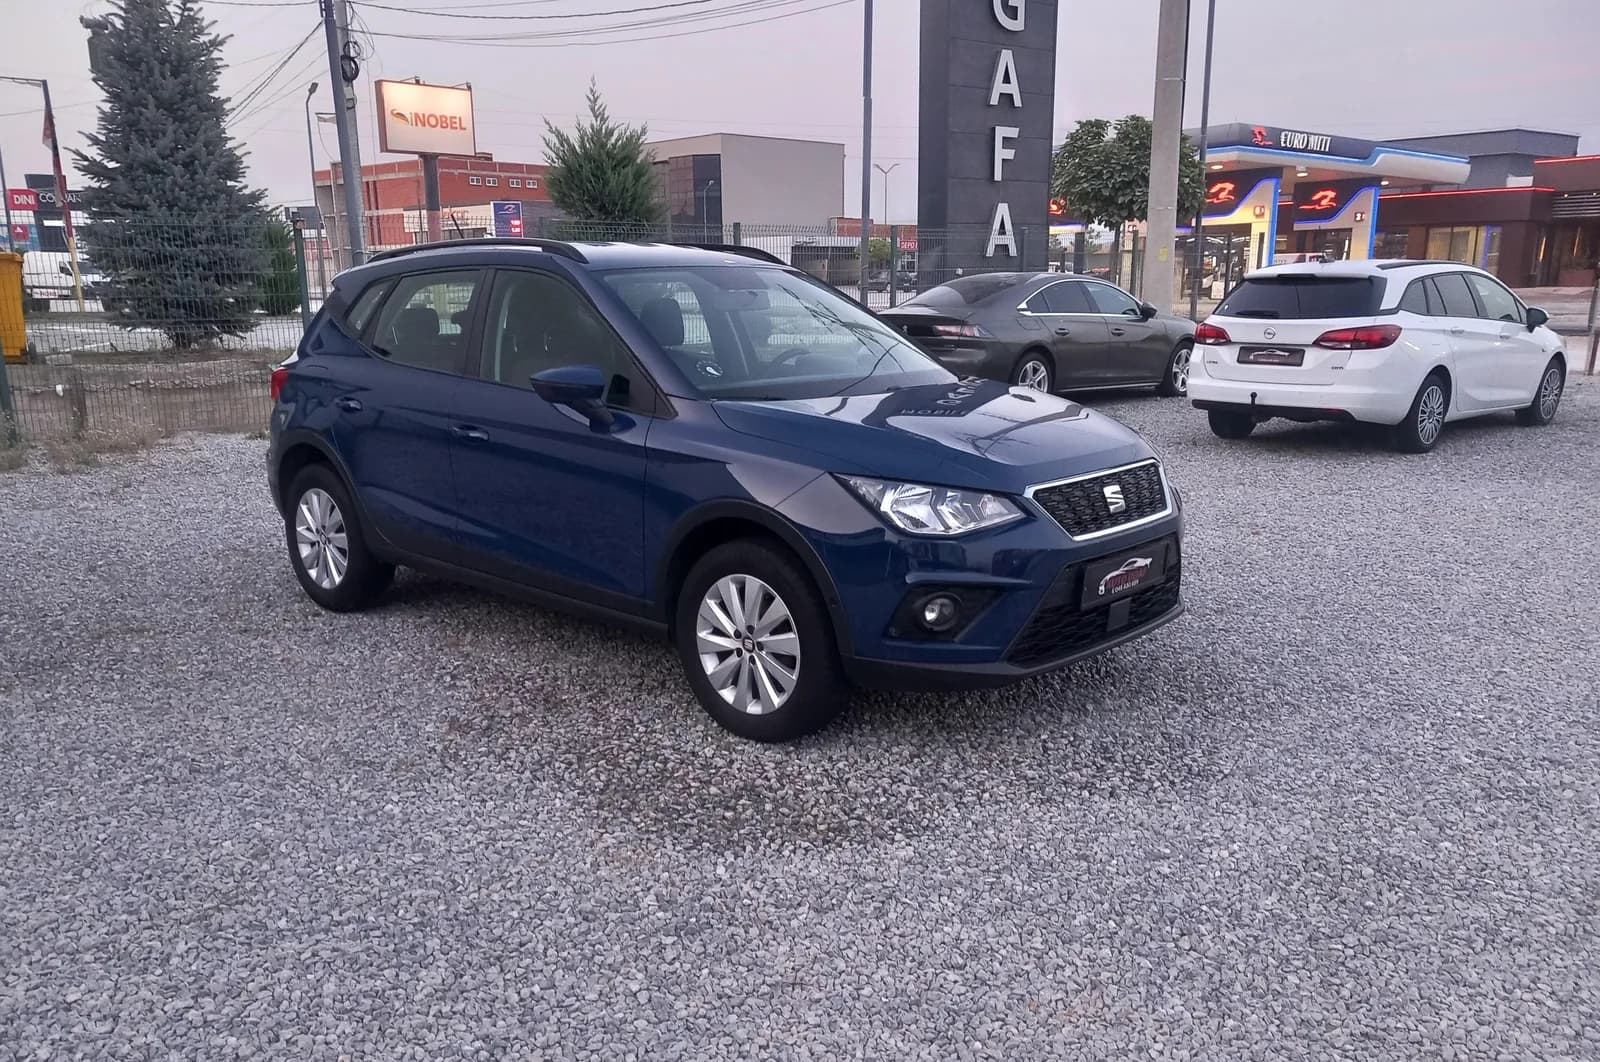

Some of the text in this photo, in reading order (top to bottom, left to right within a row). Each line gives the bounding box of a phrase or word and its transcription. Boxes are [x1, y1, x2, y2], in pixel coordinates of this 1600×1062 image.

[413, 112, 466, 131] NOBEL
[1308, 134, 1331, 152] MITI
[13, 194, 35, 205] DINI
